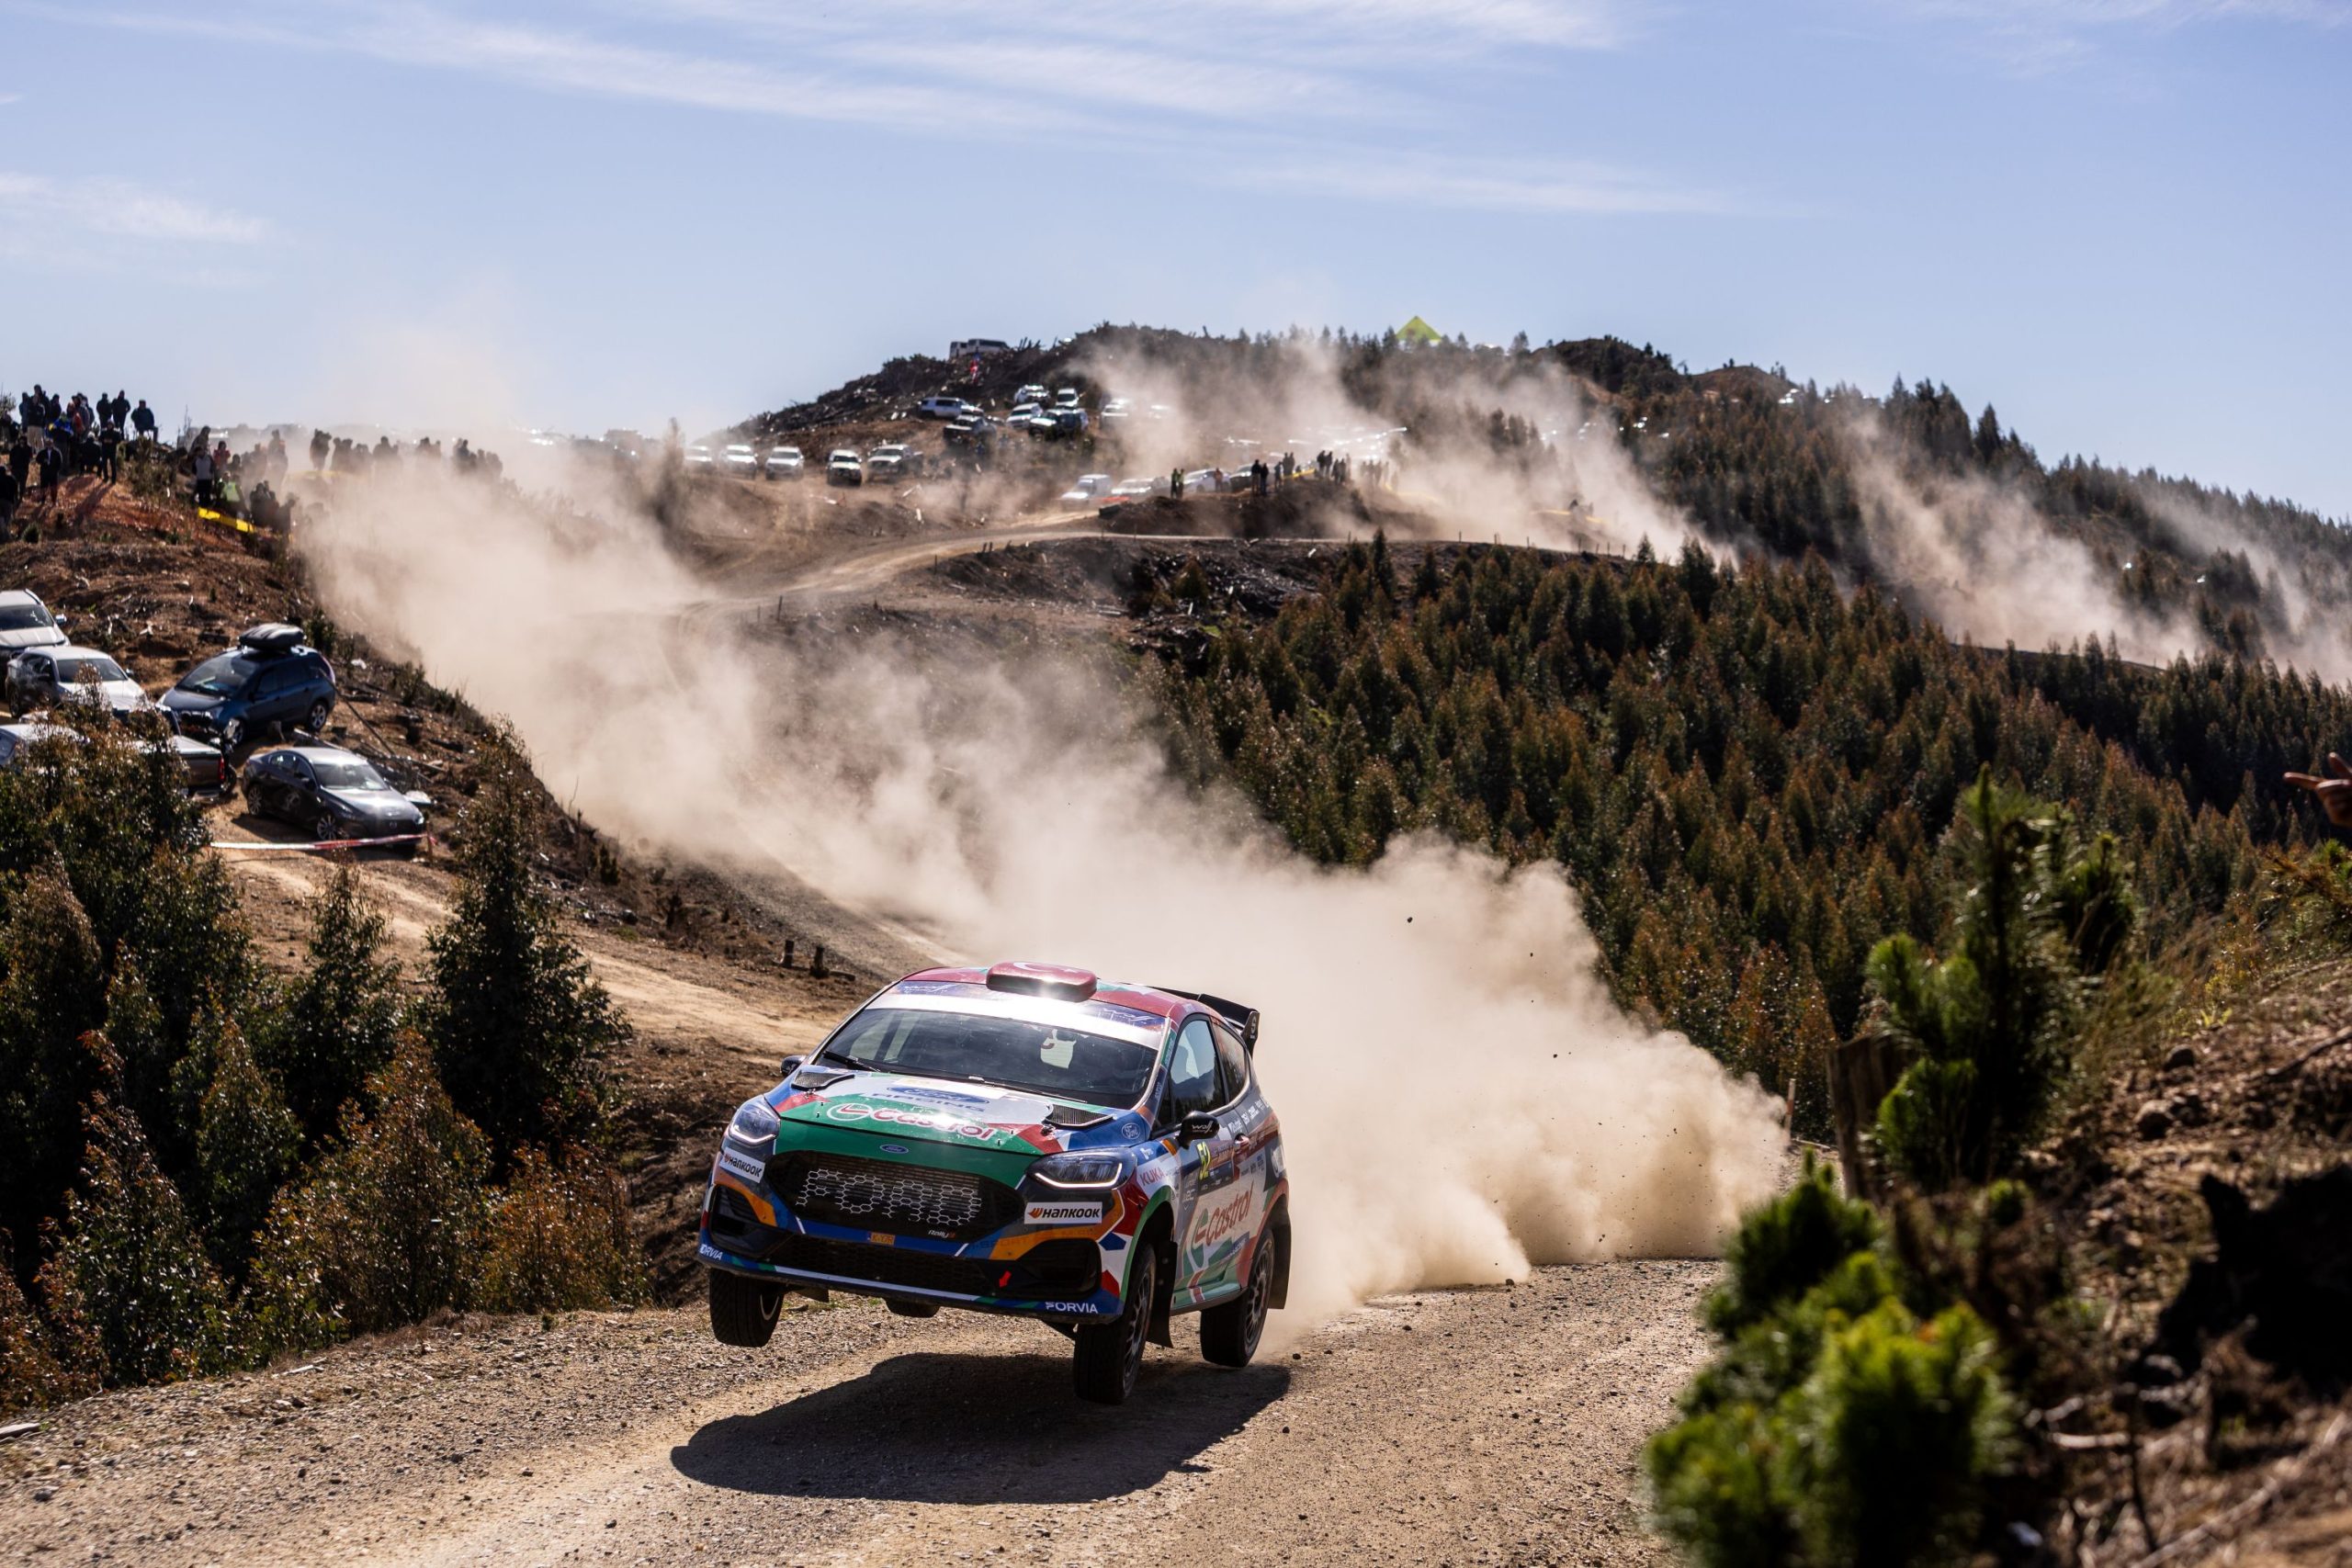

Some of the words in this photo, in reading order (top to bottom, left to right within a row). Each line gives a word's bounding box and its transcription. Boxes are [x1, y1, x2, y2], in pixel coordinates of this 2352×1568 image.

[872, 1108, 996, 1140] Casrol
[1140, 1166, 1164, 1186] KUKA
[796, 1168, 981, 1226] FORD
[1206, 1179, 1254, 1247] Castrol
[1045, 1302, 1098, 1314] FORVIA
